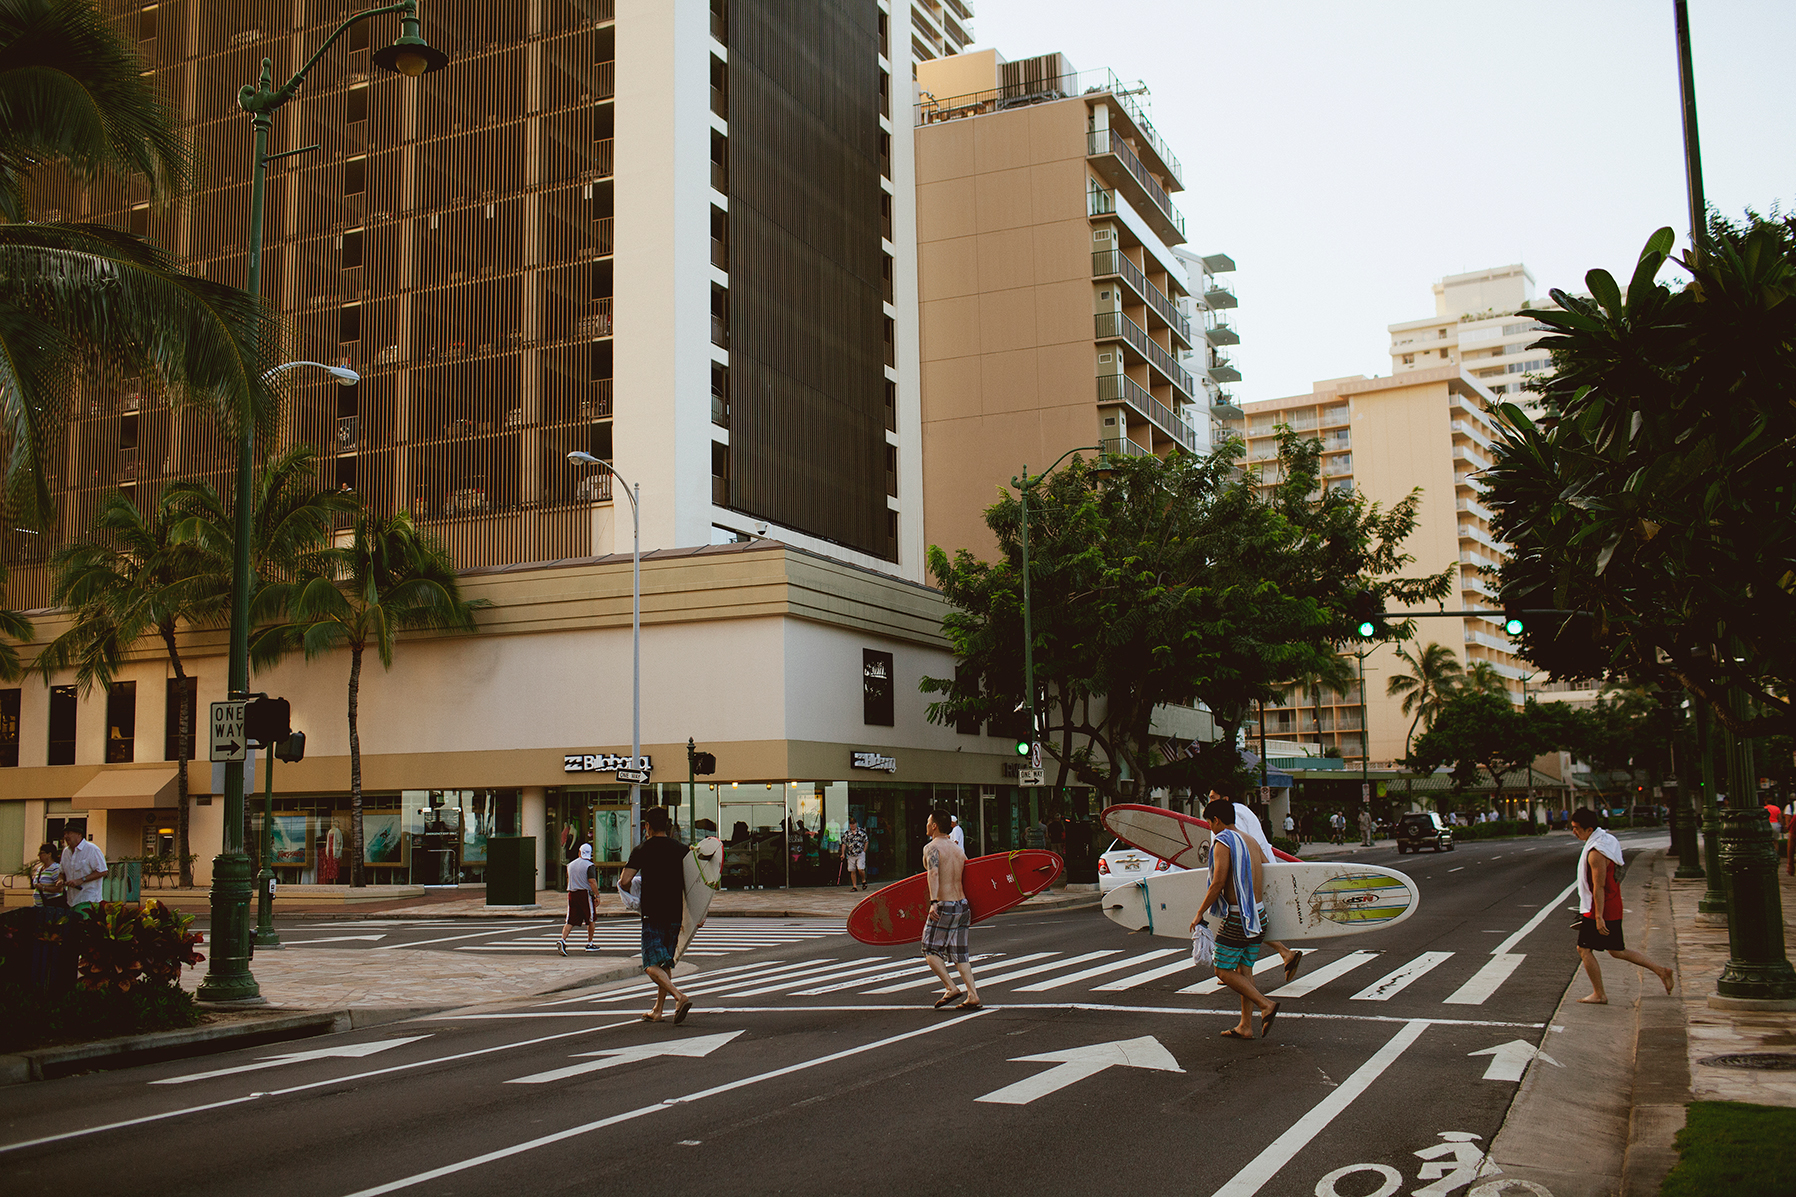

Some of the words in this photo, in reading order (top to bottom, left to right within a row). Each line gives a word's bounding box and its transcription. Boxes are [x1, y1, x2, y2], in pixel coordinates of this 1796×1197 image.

[215, 706, 244, 721] ONE
[215, 723, 244, 738] WAY
[1021, 770, 1031, 778] ONE
[1033, 770, 1043, 778] WAY
[1346, 895, 1374, 903] NSP
